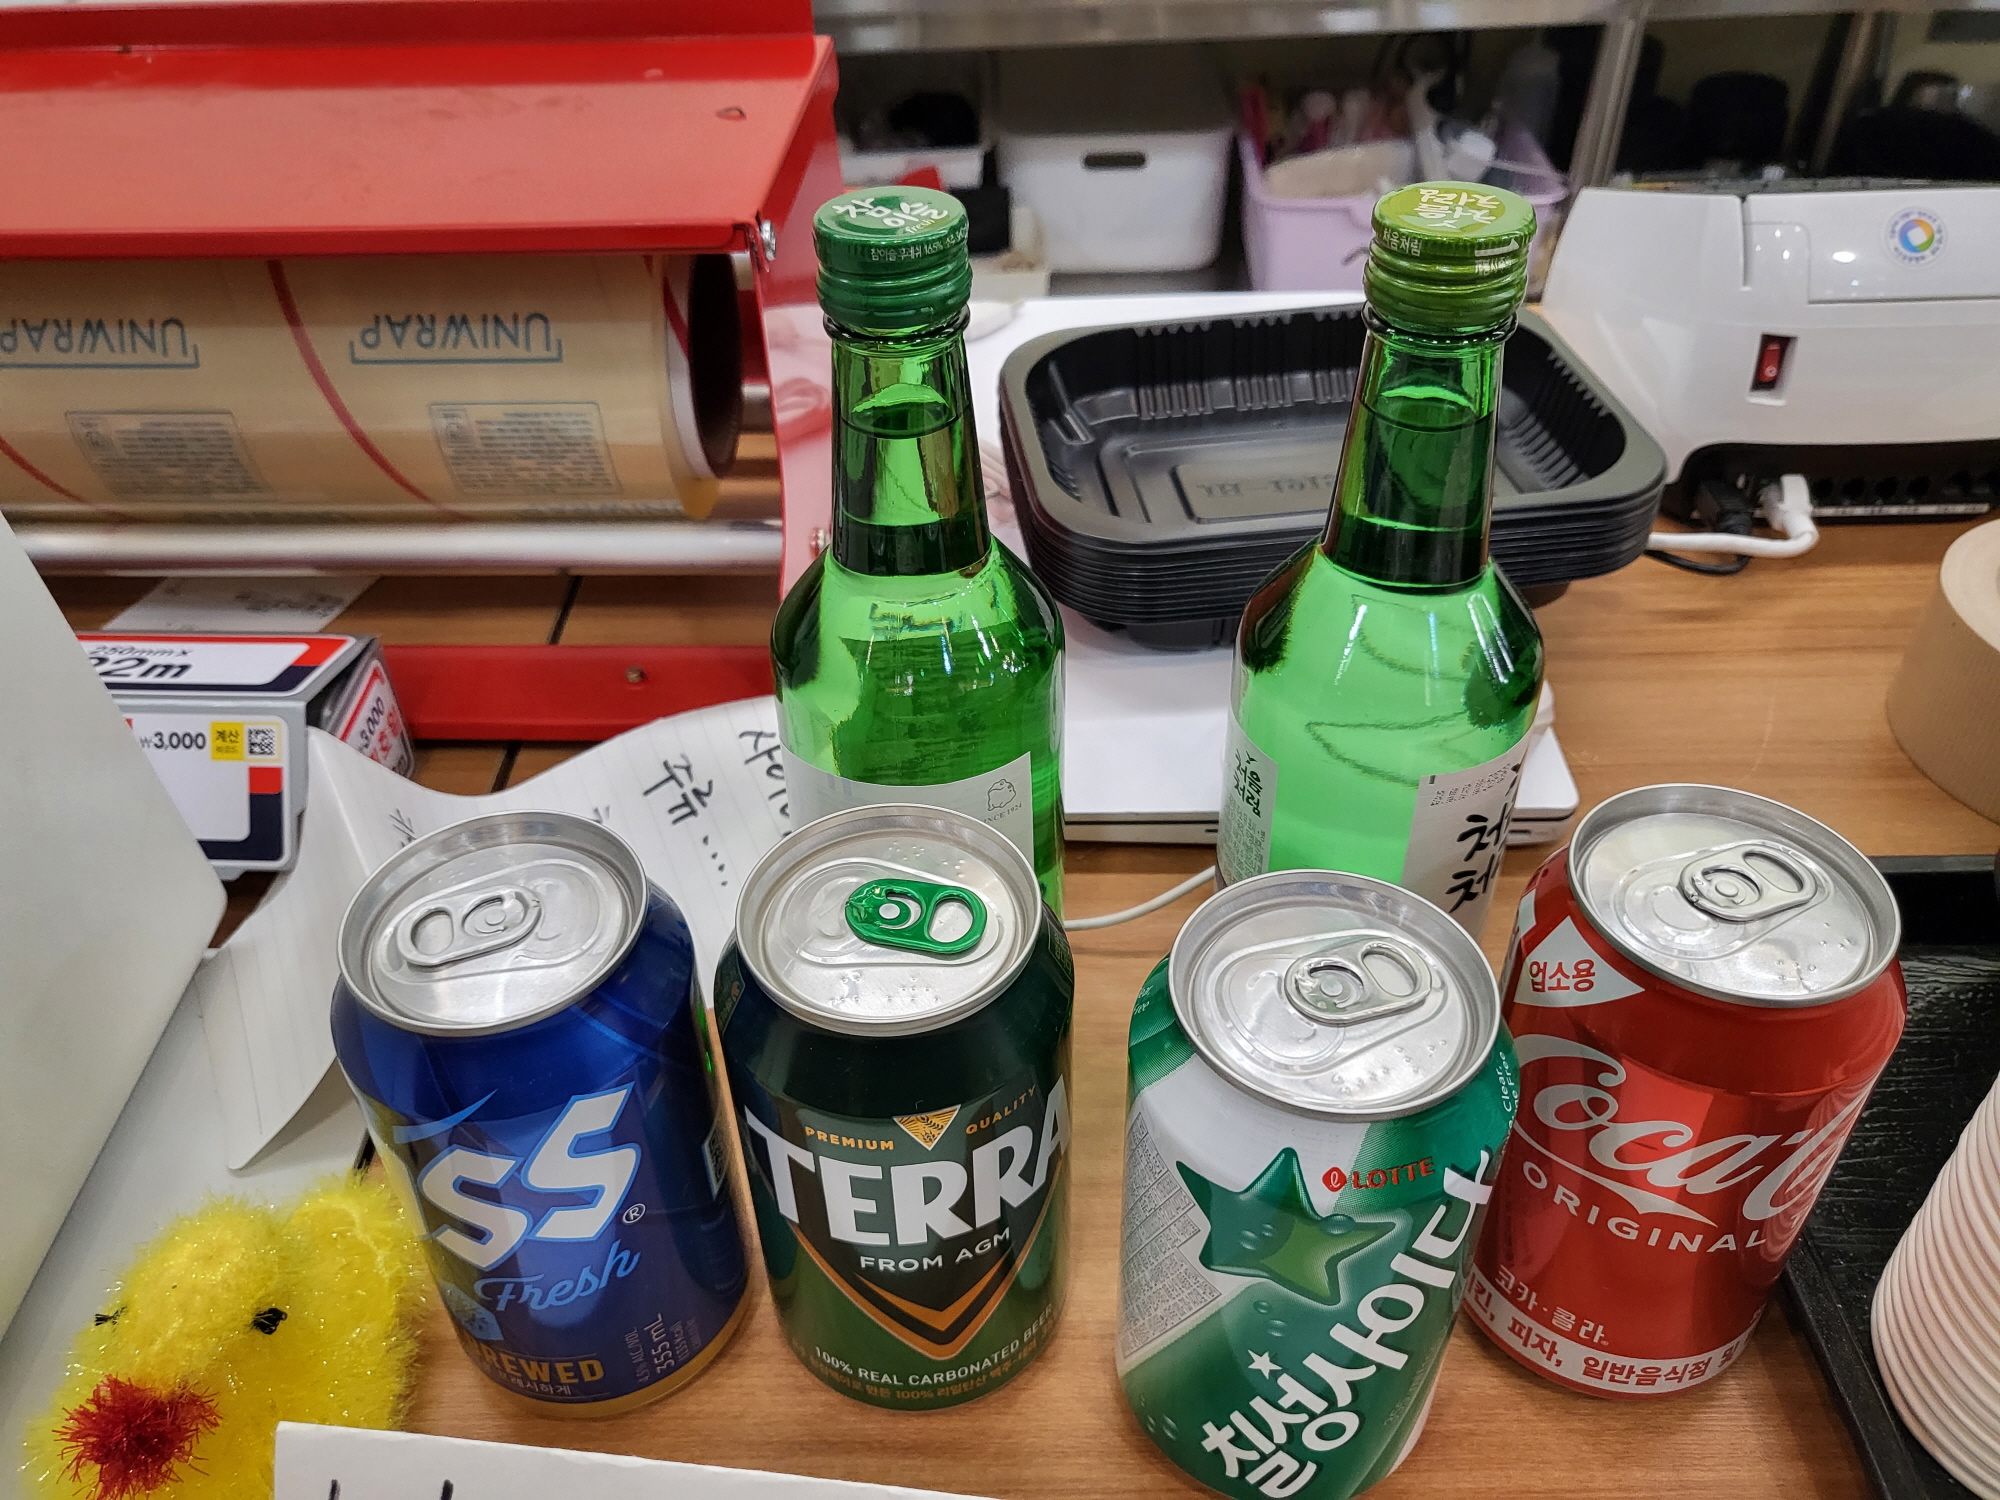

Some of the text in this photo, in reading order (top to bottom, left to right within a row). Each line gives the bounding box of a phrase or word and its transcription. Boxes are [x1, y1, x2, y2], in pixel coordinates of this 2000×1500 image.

[832, 197, 948, 228] 참이슬
[904, 218, 936, 234] fresh
[1383, 227, 1423, 257] 처음처럼
[0, 316, 189, 357] UNIWRAP
[359, 312, 552, 352] UNIWRAP
[983, 811, 1006, 824] INCE
[1529, 958, 1596, 993] 업소용
[805, 1084, 1037, 1151] PREMIUM QUALITY
[744, 1074, 1072, 1246] TERRA
[1352, 1156, 1435, 1190] LOTTE
[1522, 1160, 1767, 1253] ORIGINAL
[860, 1227, 1011, 1272] FROM AGM
[474, 1239, 641, 1311] Fresh
[643, 1312, 675, 1374] 355 mL
[815, 1346, 854, 1375] 100%
[858, 1367, 904, 1385] REAL
[908, 1339, 1020, 1386] CARBONATED
[1023, 1303, 1052, 1343] BEER
[1200, 1149, 1494, 1499] 칠성사이다
[473, 1340, 605, 1384] REWED
[1507, 1316, 1563, 1368] 피자,
[1582, 1355, 1713, 1387] 일반음식점
